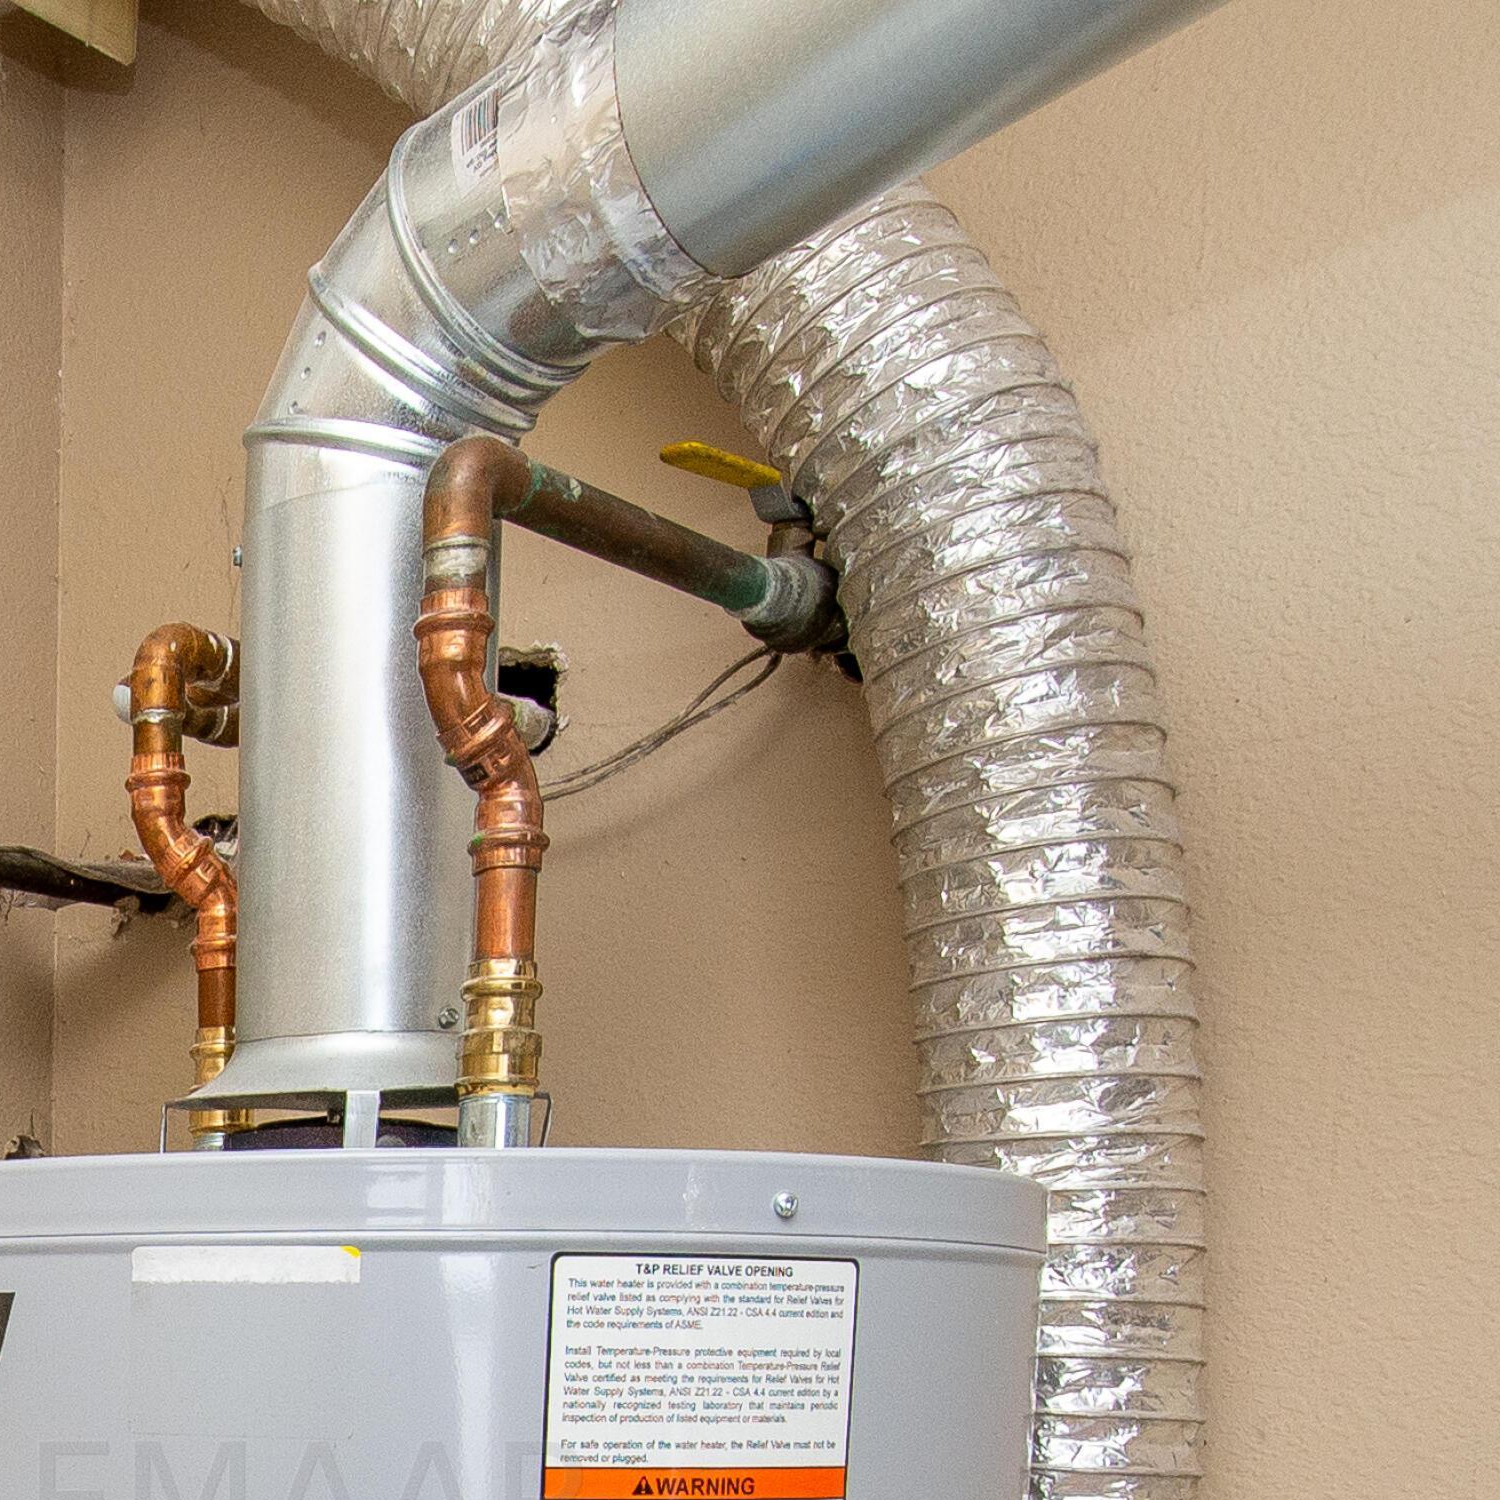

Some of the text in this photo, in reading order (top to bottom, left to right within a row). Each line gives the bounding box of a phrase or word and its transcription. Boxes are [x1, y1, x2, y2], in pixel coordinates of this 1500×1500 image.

[637, 1263, 793, 1277] T&P RELIEF VALVE OPENING
[656, 1477, 756, 1496] WARNING
